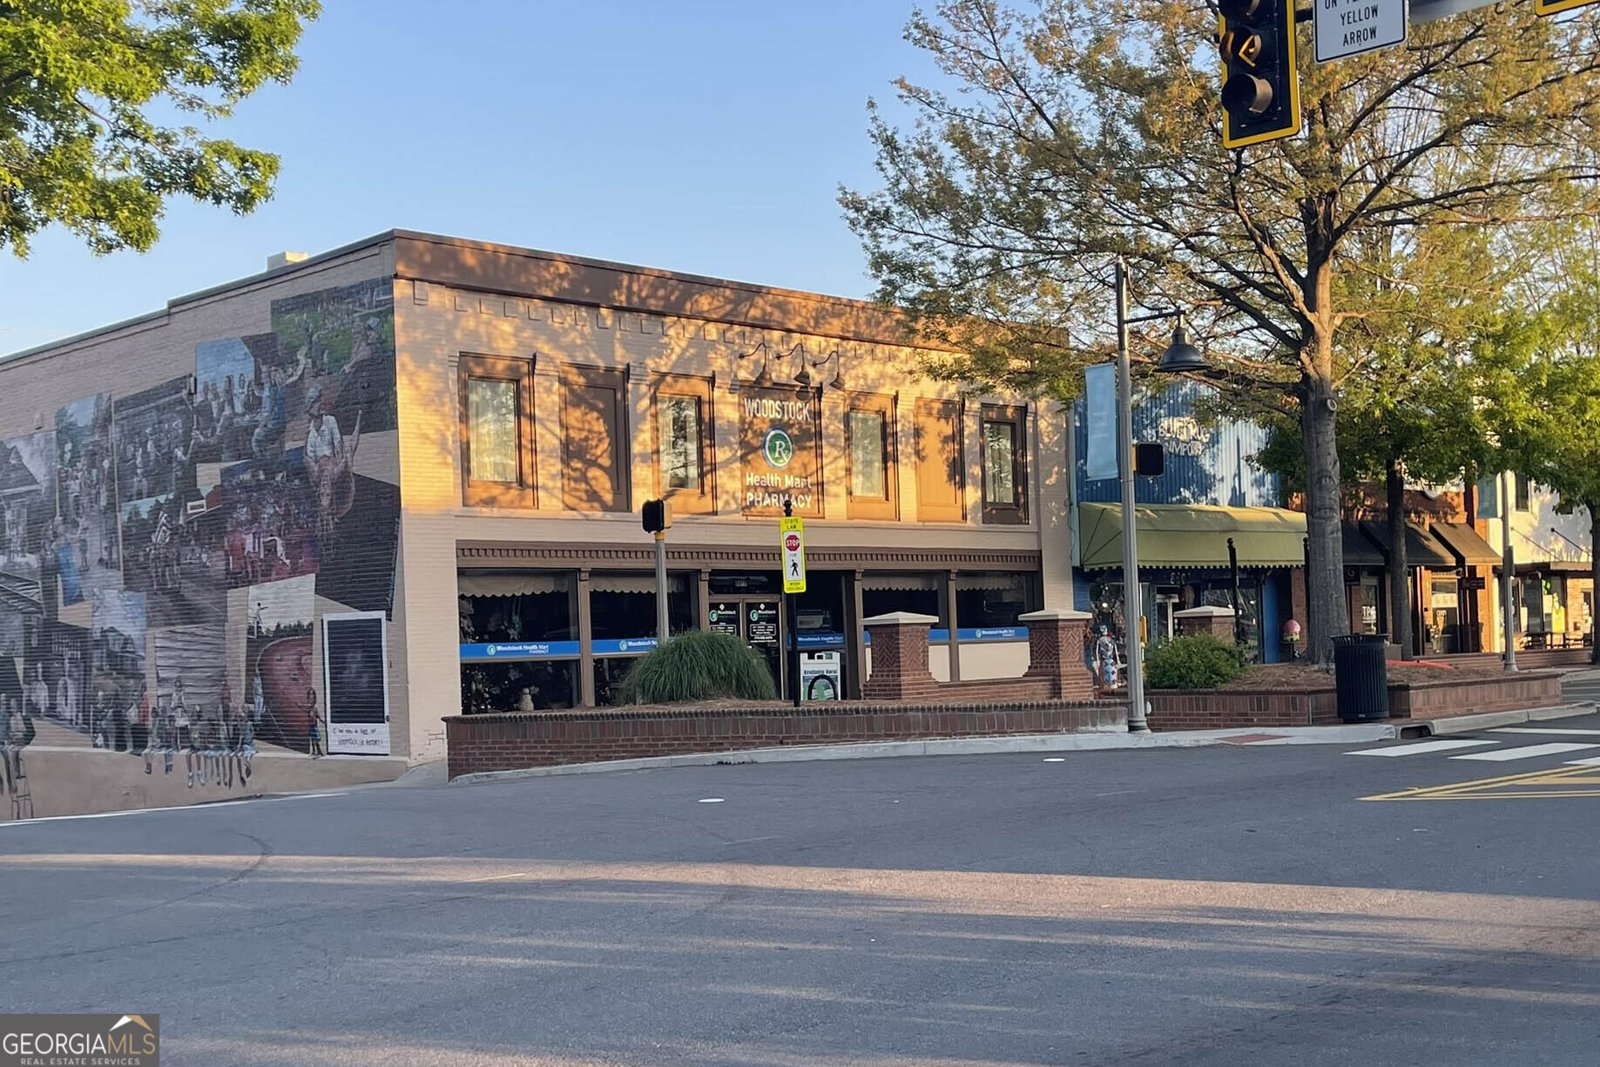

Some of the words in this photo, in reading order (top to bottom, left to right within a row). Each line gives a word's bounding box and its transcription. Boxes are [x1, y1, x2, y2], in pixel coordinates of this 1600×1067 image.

[1340, 4, 1379, 26] YELLOW
[1343, 26, 1377, 47] ARROW
[744, 398, 811, 421] WOODSTOCK
[746, 472, 782, 488] Health
[785, 475, 812, 489] Mart
[746, 492, 812, 508] PHARMACY
[786, 539, 800, 547] STOP
